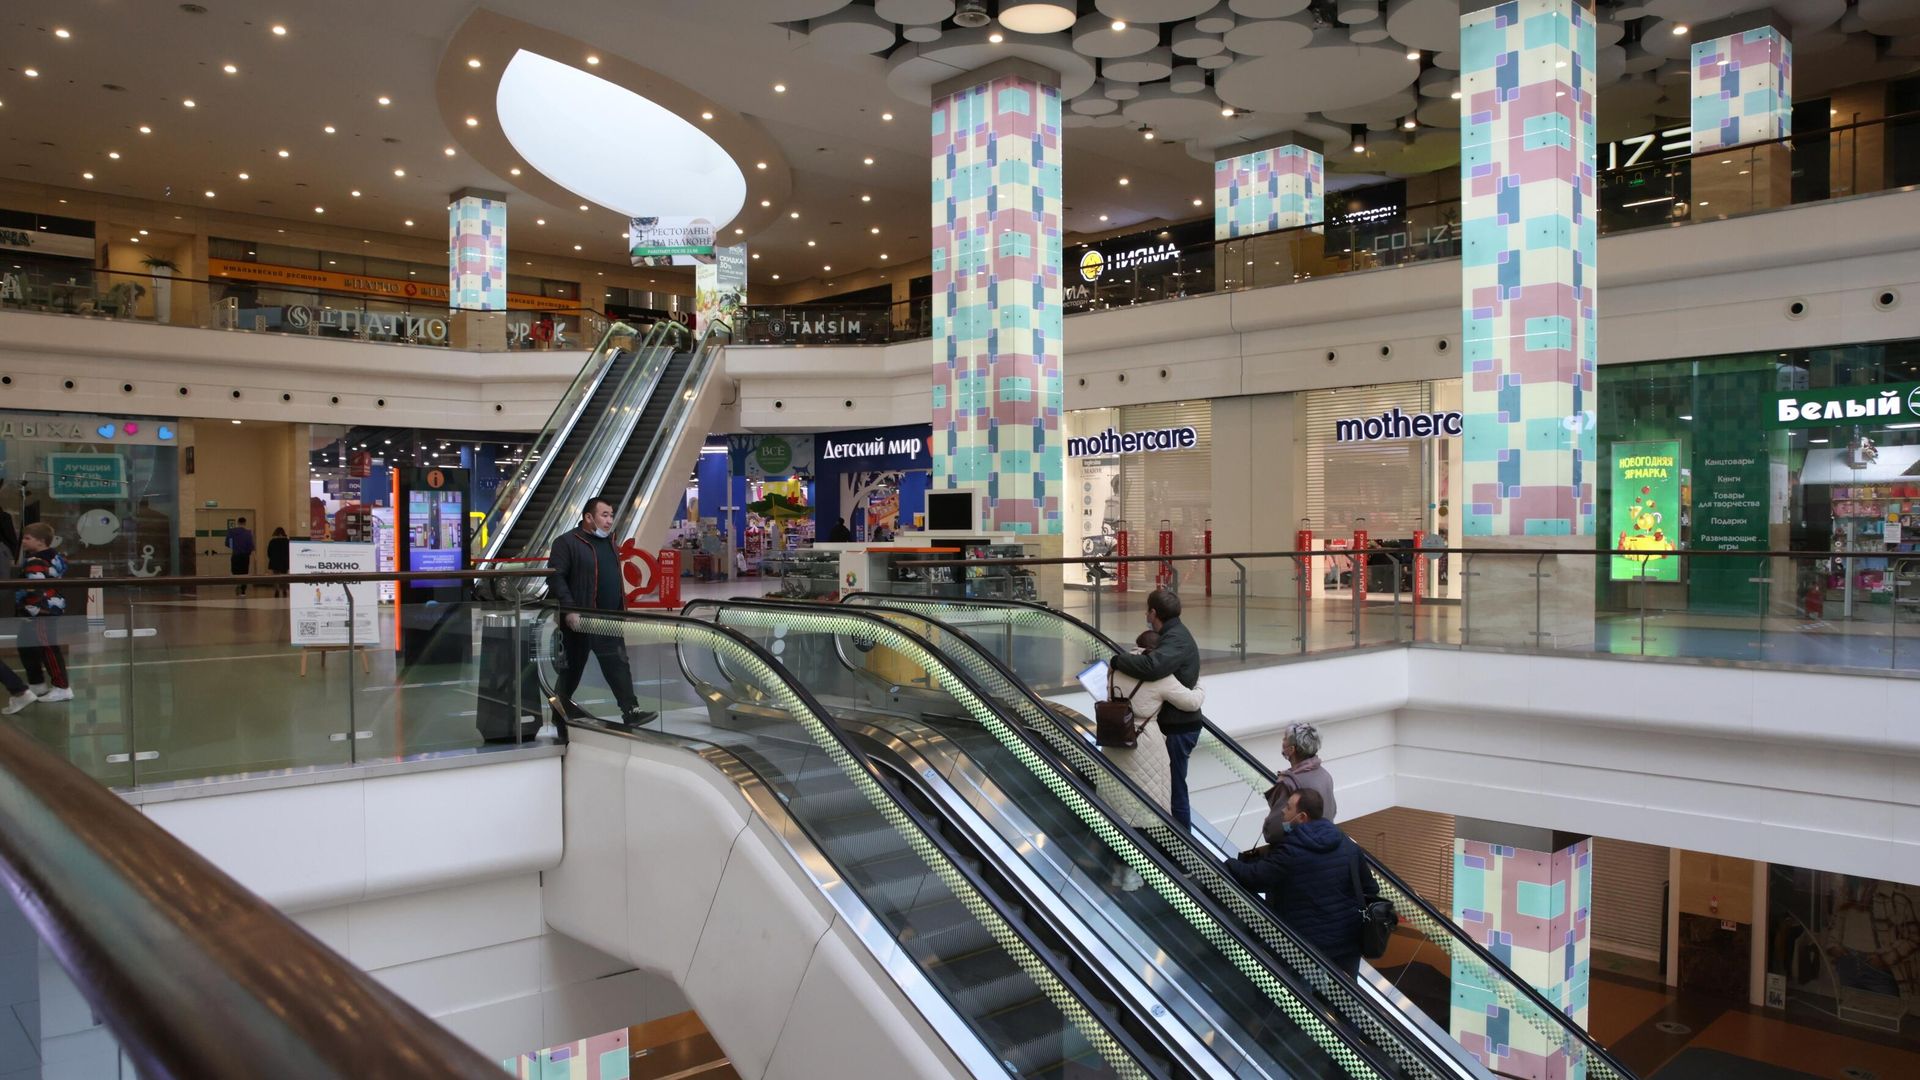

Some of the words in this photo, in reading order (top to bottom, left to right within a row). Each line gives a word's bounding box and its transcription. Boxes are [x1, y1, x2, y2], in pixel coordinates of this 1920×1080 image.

[636, 229, 645, 241] 4
[652, 226, 709, 237] РЕСТОРАНЫ
[652, 238, 666, 247] НА
[668, 237, 712, 247] БАЛКОНЕ
[719, 255, 744, 265] СКИДКА
[339, 311, 447, 340] ПАТИО
[1778, 390, 1901, 422] Белый
[1336, 408, 1463, 441] motherc
[1067, 425, 1196, 457] mothercare
[823, 437, 884, 459] Детский
[888, 437, 921, 460] мир
[1619, 456, 1673, 468] НОВОГОДНЯЯ
[1705, 458, 1755, 466] Канцтовары
[64, 464, 111, 472] ЛУЧШИЙ
[1625, 468, 1667, 479] ЯРМАРКА
[1711, 517, 1747, 525] Подарки
[1700, 534, 1757, 542] Развивающие
